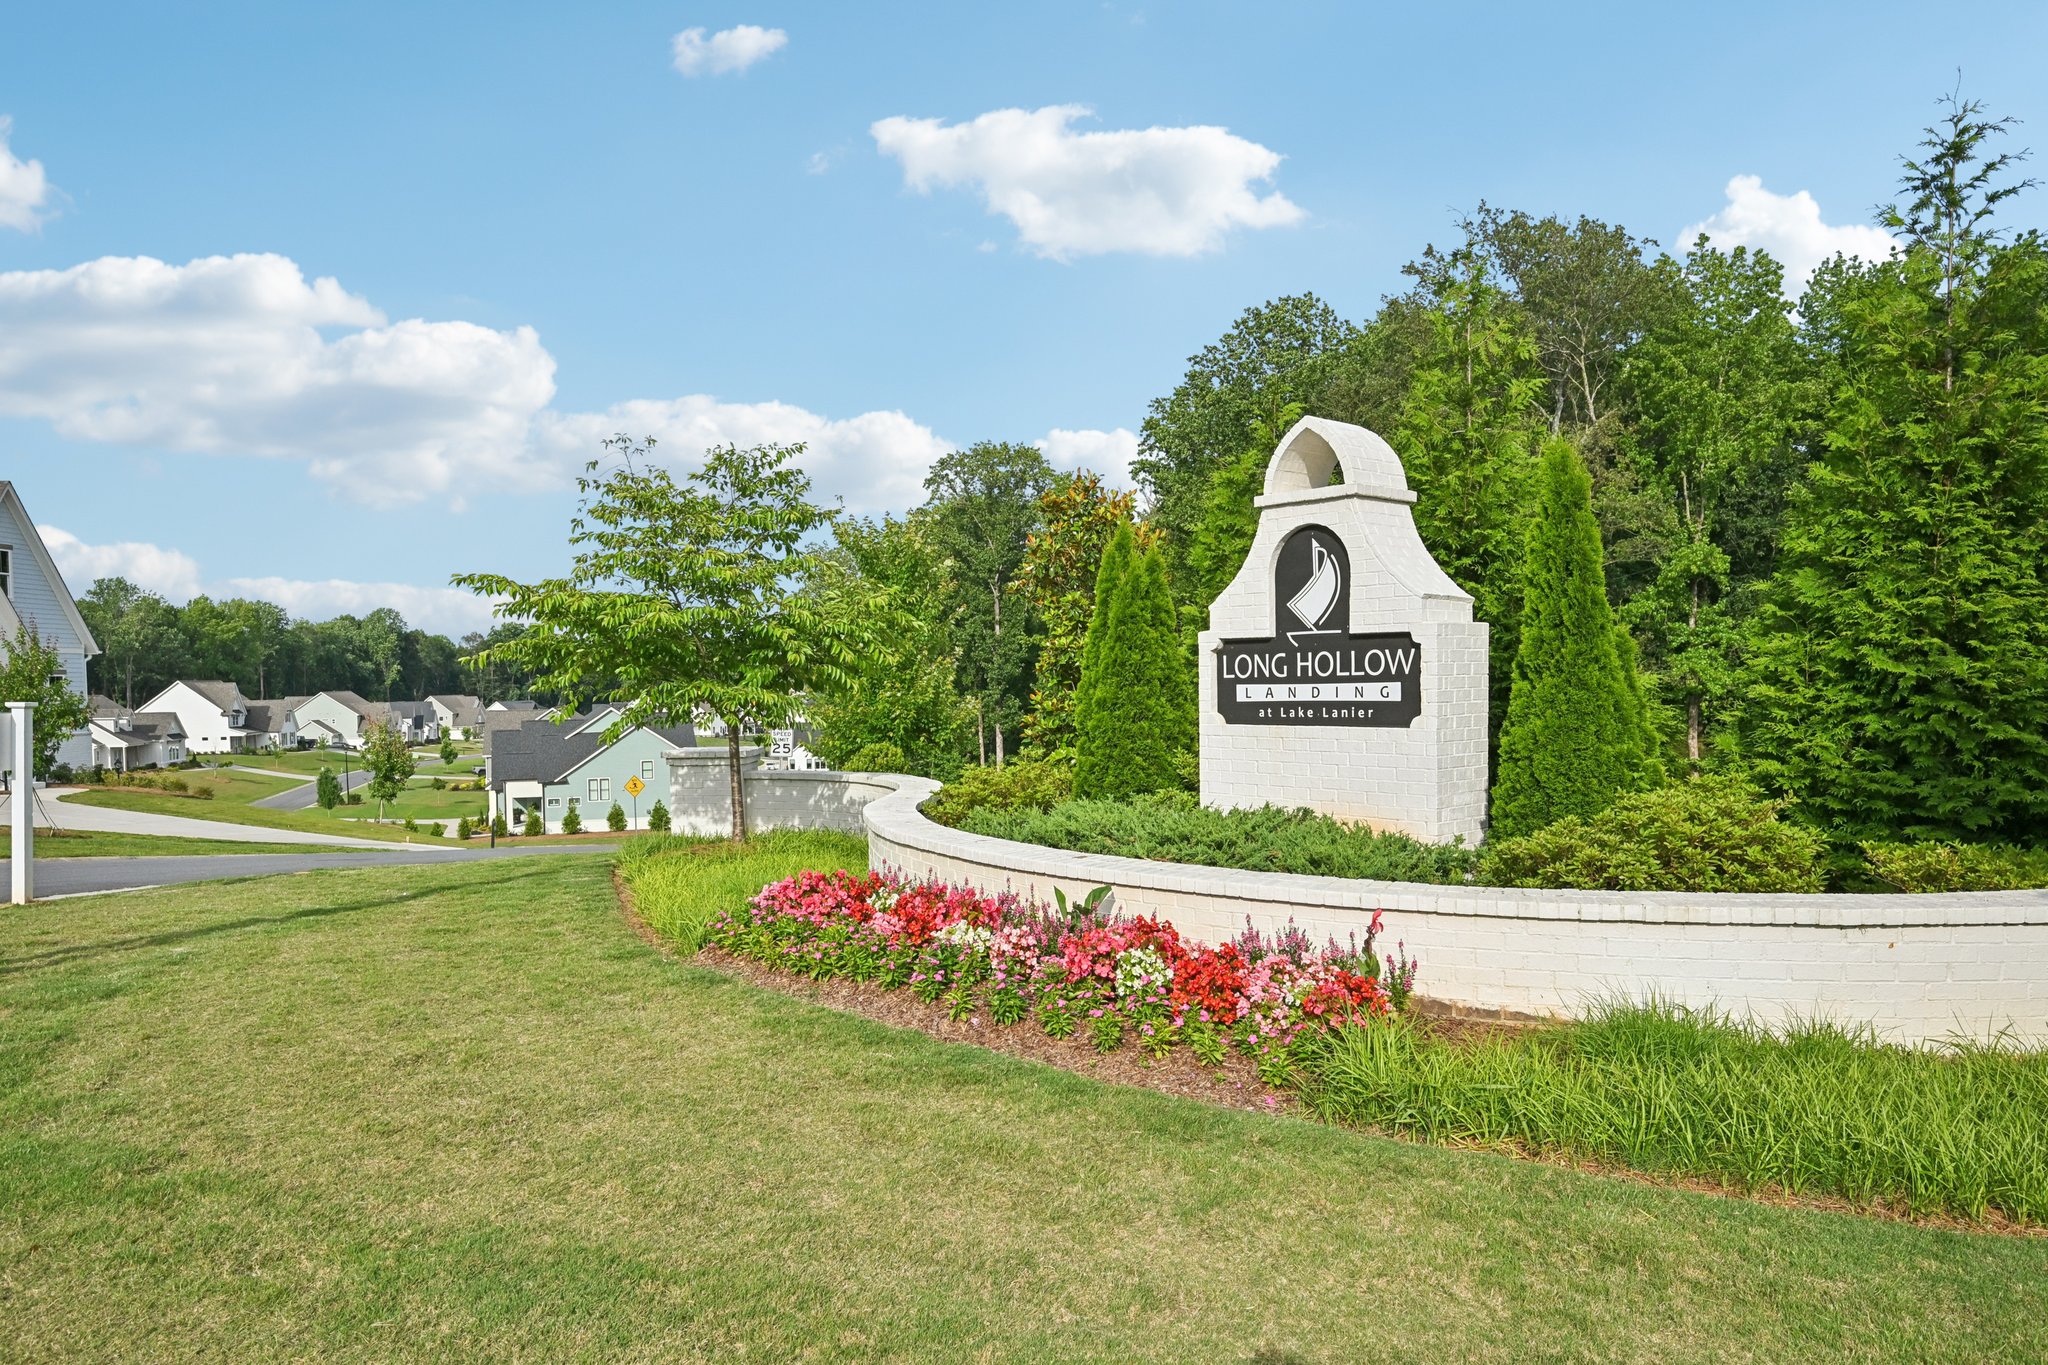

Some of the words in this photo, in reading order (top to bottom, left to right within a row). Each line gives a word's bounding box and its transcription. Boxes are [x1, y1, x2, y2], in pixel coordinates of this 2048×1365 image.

[1223, 653, 1287, 678] LONG
[1297, 648, 1415, 677] HOLLOW
[1245, 686, 1390, 699] LANDING
[1259, 708, 1272, 718] at
[1280, 707, 1314, 718] Lake
[1322, 707, 1374, 718] Lanier
[772, 744, 790, 754] 25
